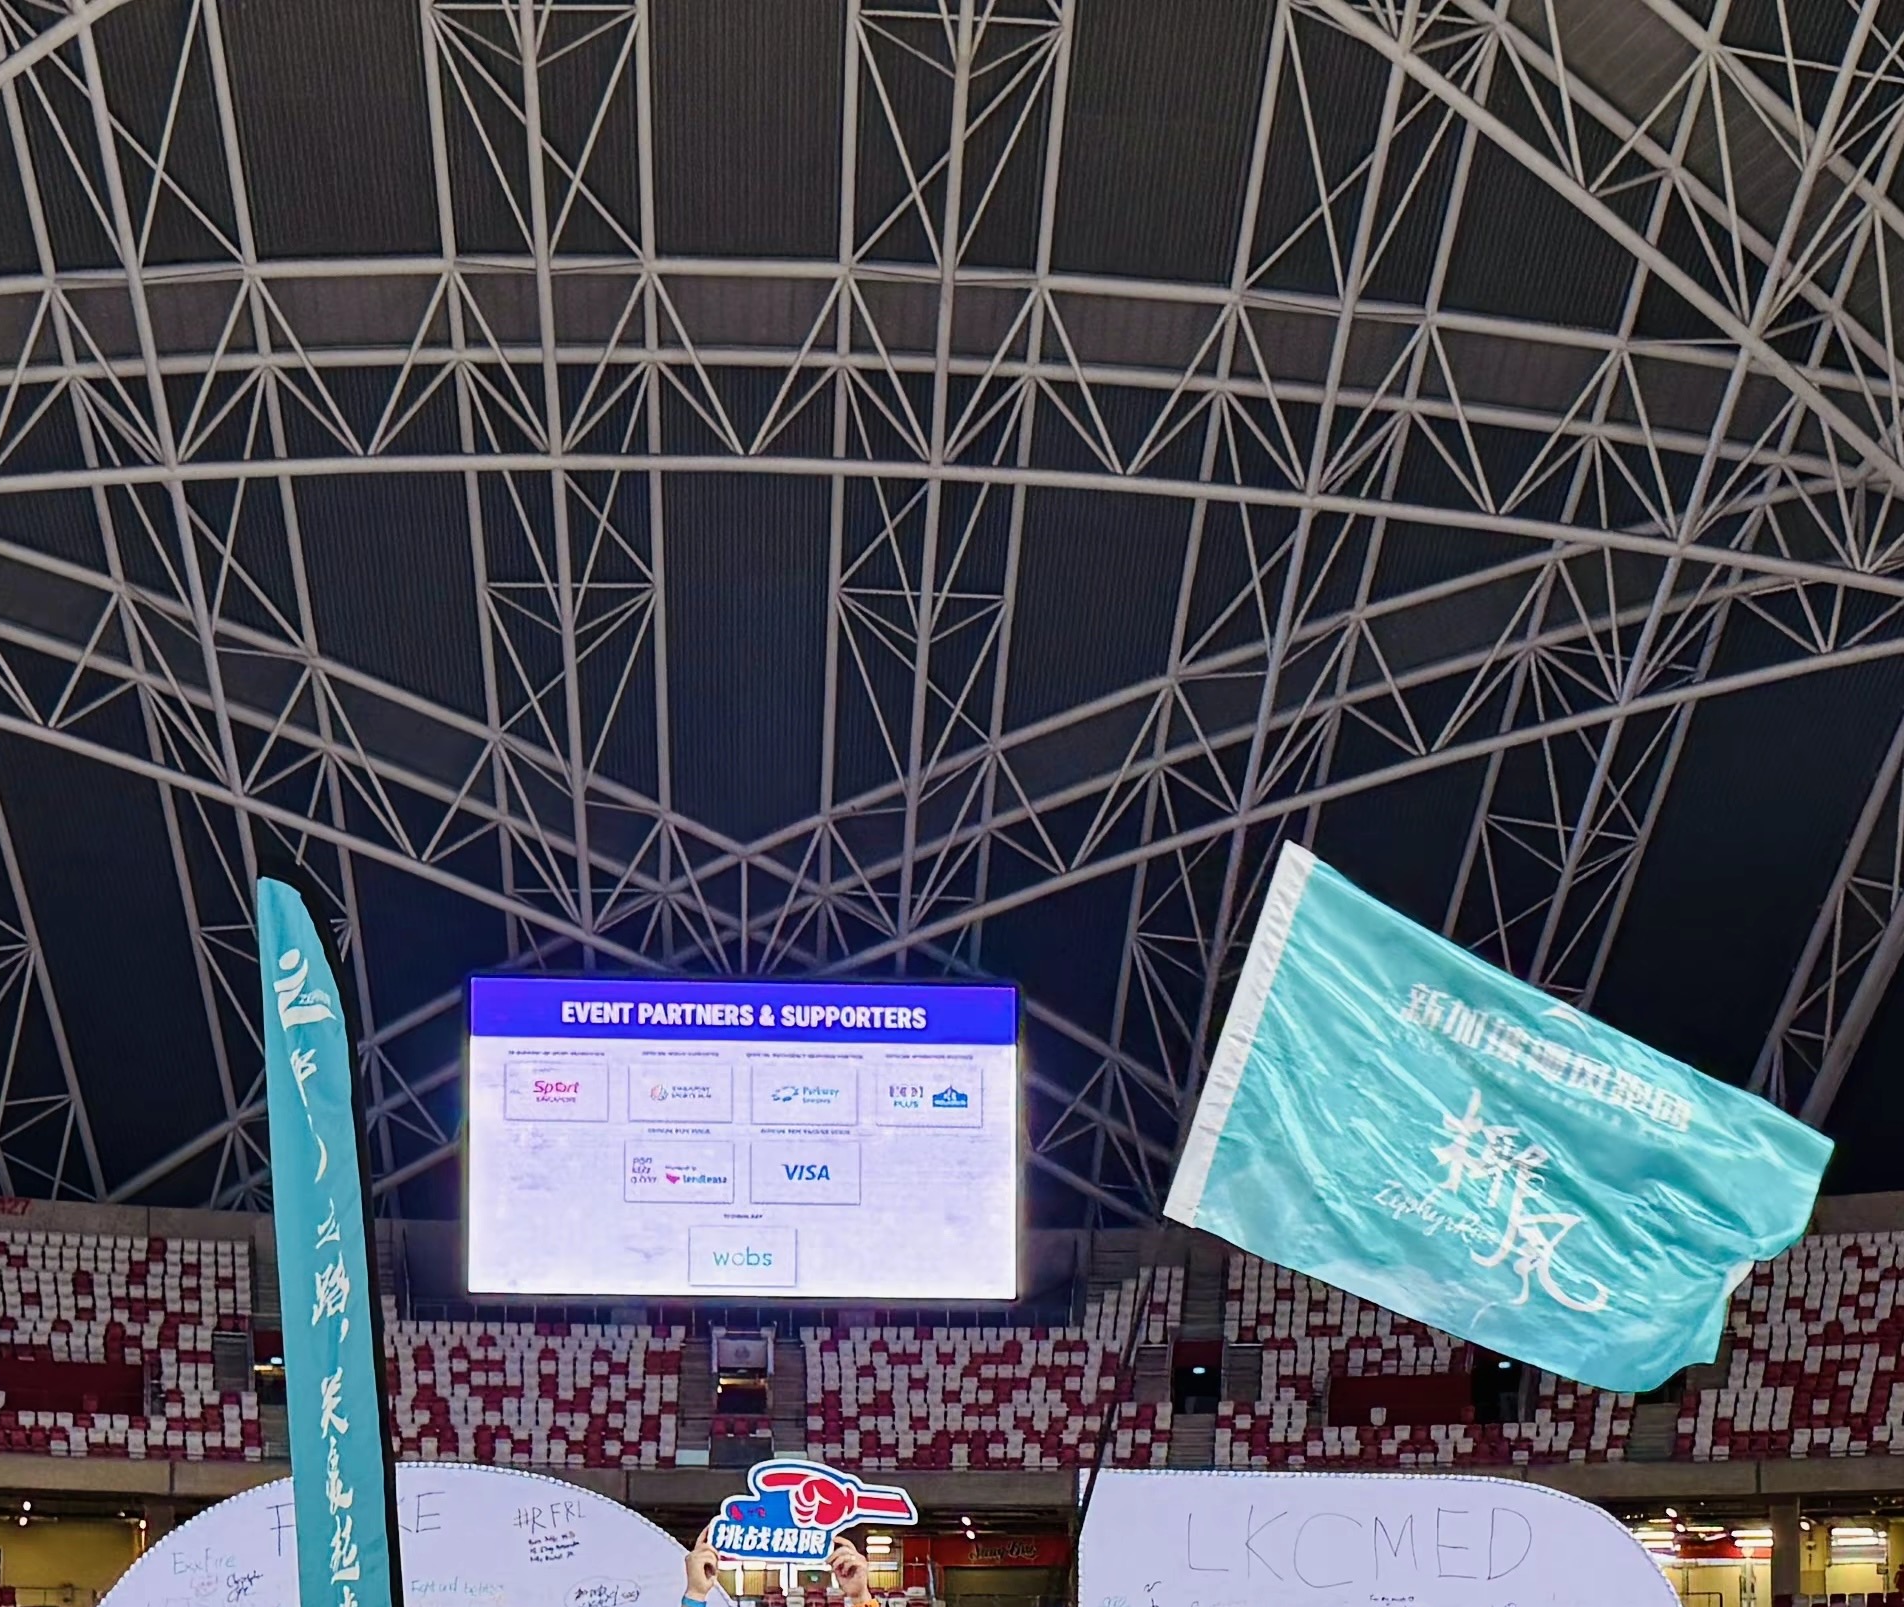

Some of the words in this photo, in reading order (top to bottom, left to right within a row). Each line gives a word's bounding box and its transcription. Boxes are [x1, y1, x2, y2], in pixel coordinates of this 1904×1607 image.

[560, 1001, 634, 1024] EVENT
[637, 1002, 754, 1027] PARTNERS
[759, 1006, 775, 1027] &
[780, 1005, 927, 1030] SUPPORTERS
[784, 1164, 831, 1181] VISA
[712, 1246, 773, 1268] wobs
[715, 1522, 828, 1556] 挑战极限
